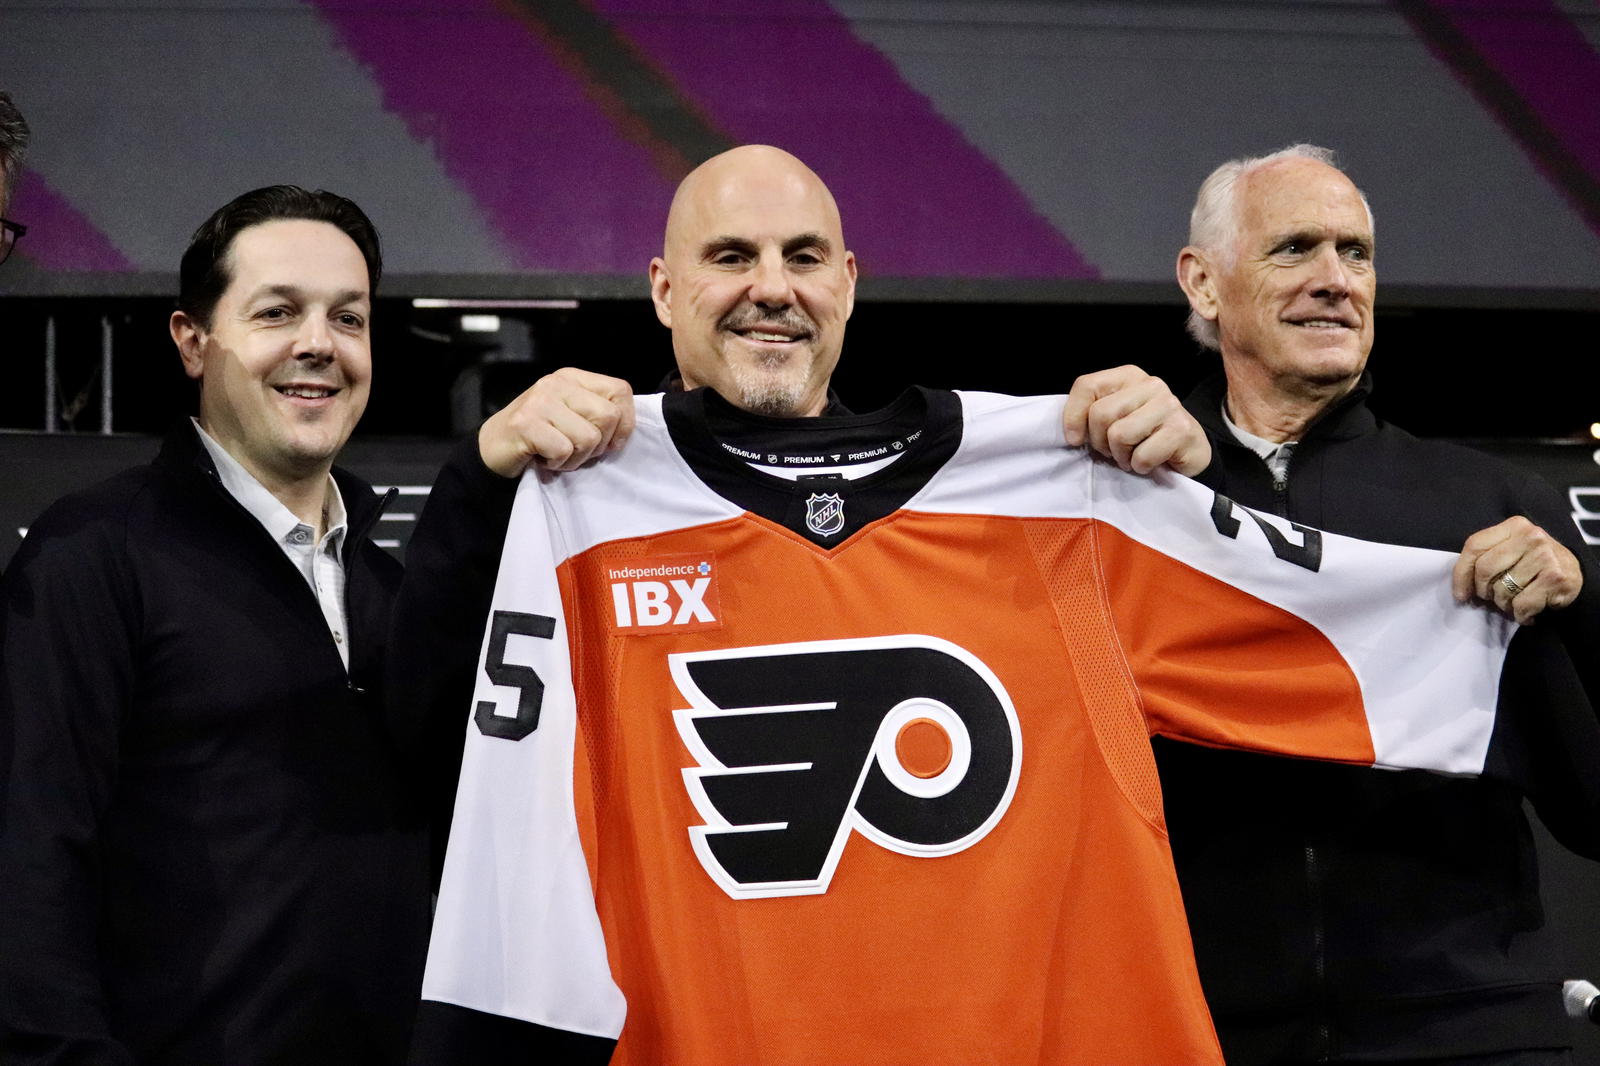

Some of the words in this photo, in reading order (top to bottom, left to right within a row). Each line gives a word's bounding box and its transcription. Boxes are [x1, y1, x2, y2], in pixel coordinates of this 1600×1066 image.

[722, 443, 761, 460] PREMIUM
[784, 456, 825, 464] PREMIUM
[848, 446, 888, 461] PREMIUM
[815, 504, 837, 527] NHL
[608, 564, 695, 580] Independence
[611, 577, 717, 628] IBX
[474, 609, 557, 742] 5
